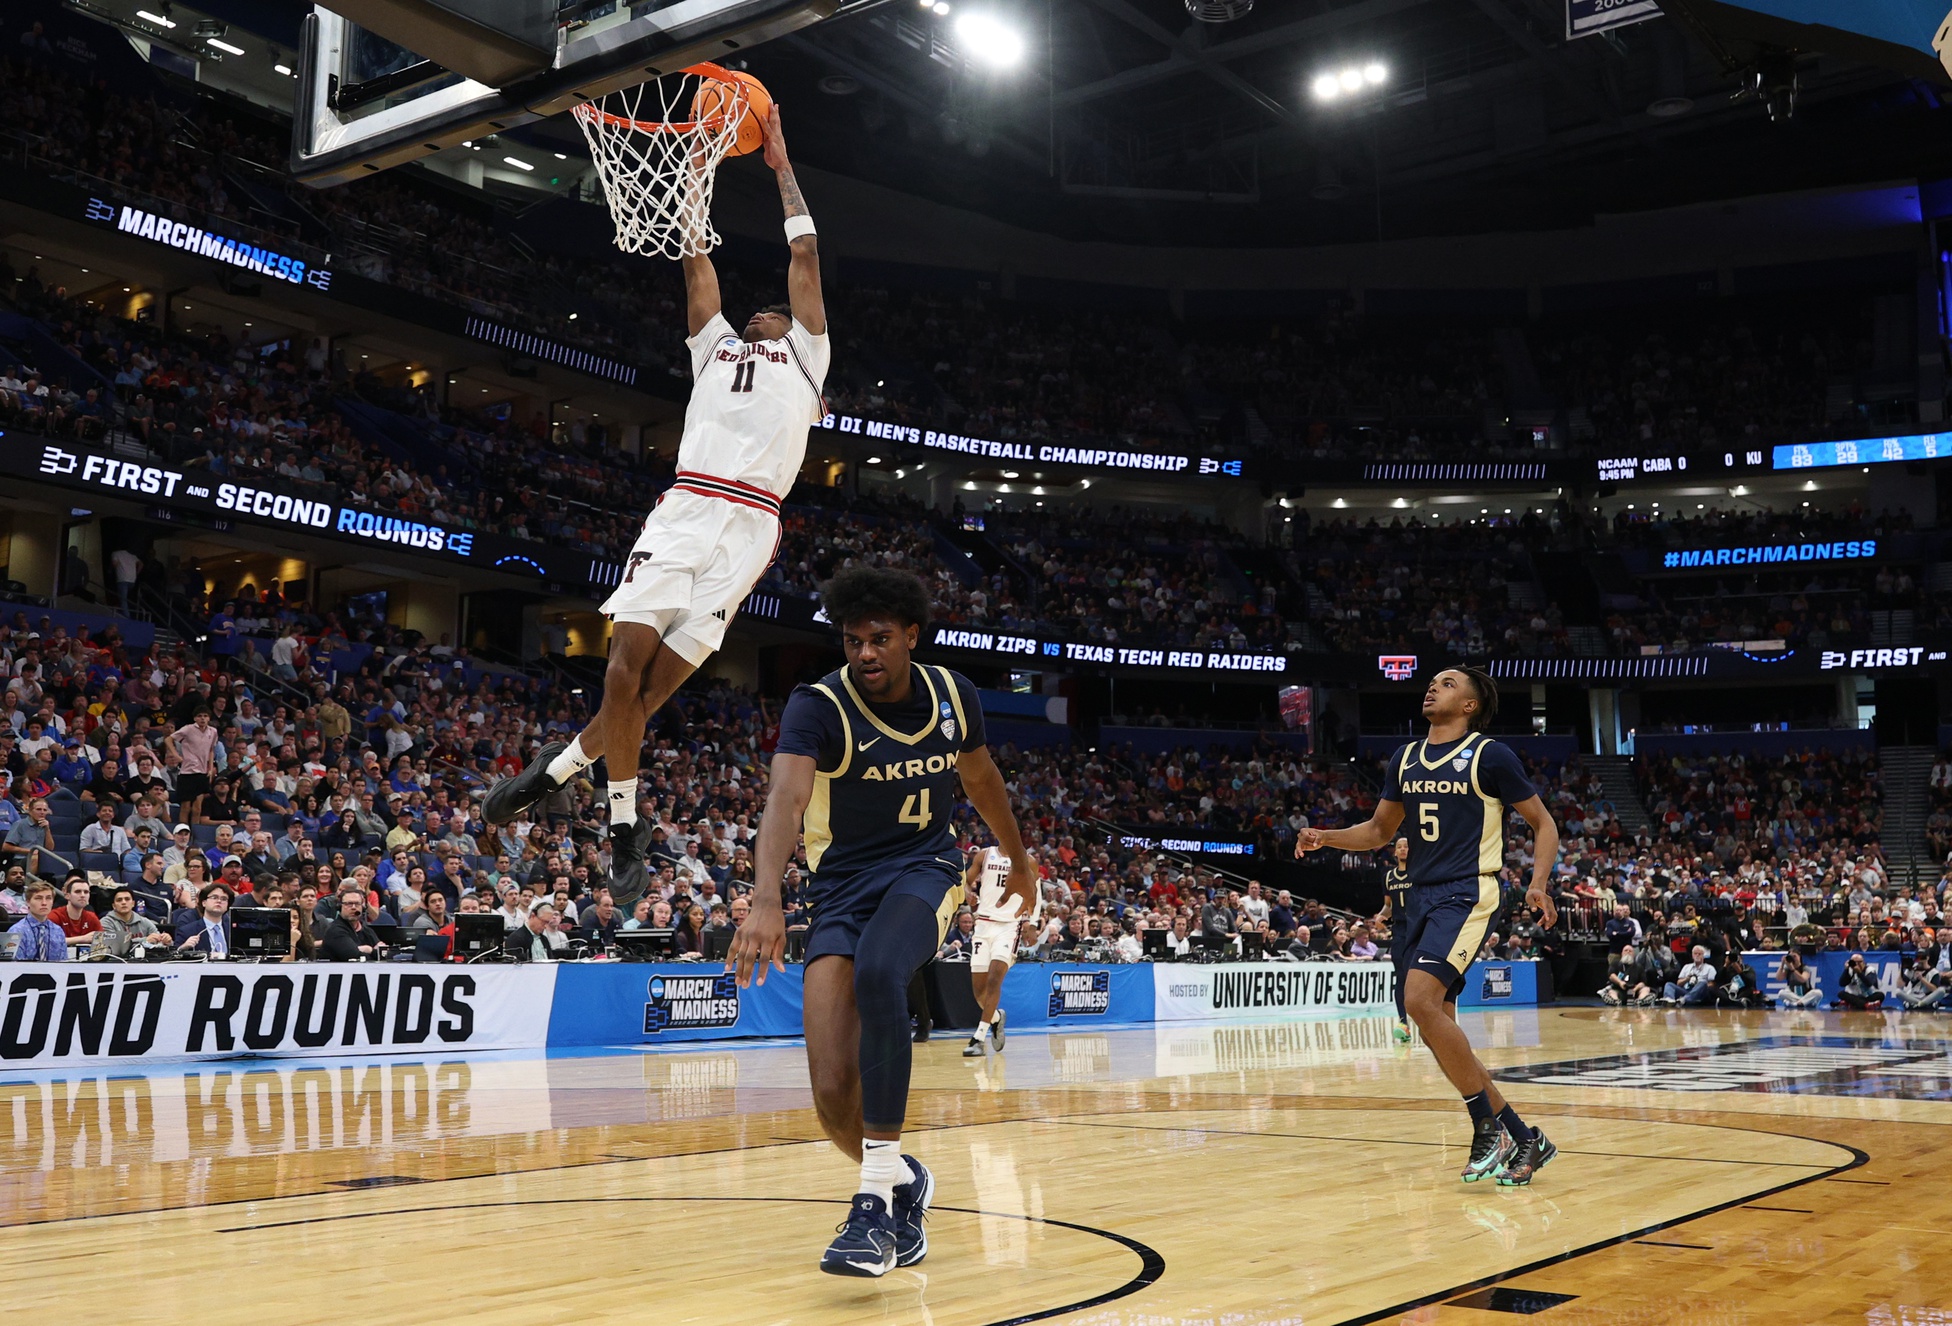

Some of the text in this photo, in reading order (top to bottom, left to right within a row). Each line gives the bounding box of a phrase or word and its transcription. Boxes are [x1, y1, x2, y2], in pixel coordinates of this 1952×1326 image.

[117, 206, 305, 284] MARCHMADNESS
[730, 361, 756, 392] 11
[839, 416, 862, 434] DI
[866, 421, 920, 443] MEN'S
[924, 431, 1035, 460] BASKETBALL
[1039, 446, 1189, 471] CHAMPIONSHIP
[1925, 446, 1937, 457] 5
[1598, 457, 1638, 470] NCAAM
[1724, 451, 1762, 467] 0 KU
[1792, 454, 1813, 467] 83
[1836, 451, 1858, 464] 29
[1882, 447, 1903, 461] 42
[1642, 456, 1687, 472] CABA 0
[1599, 468, 1634, 481] 9:45 PM
[82, 455, 444, 550] FIRST AND SECOND ROUNDS
[157, 508, 171, 520] 116
[215, 520, 228, 531] 117
[1664, 540, 1876, 568] #MARCHMADNESS
[934, 629, 1286, 671] AKRON ZIPS VS TEXAS TECH RED RAIDERS
[1850, 647, 1946, 668] FIRST AND
[861, 750, 960, 781] AKRON
[1402, 780, 1468, 795] AKRON
[898, 788, 933, 832] 4
[1419, 803, 1440, 842] 5
[1161, 839, 1201, 852] SECOND
[1203, 842, 1243, 854] ROUNDS
[664, 979, 713, 1000] MARCH
[1061, 975, 1093, 991] MARCH
[1169, 984, 1198, 998] HOSTED
[1200, 984, 1209, 997] BY
[1212, 971, 1311, 1009] UNIVERSITY
[1314, 971, 1334, 1005] OF
[1338, 971, 1385, 1005] SOUTH
[1064, 991, 1108, 1008] MADNESS
[0, 973, 476, 1059] OND ROUNDS
[671, 999, 738, 1020] MADNESS
